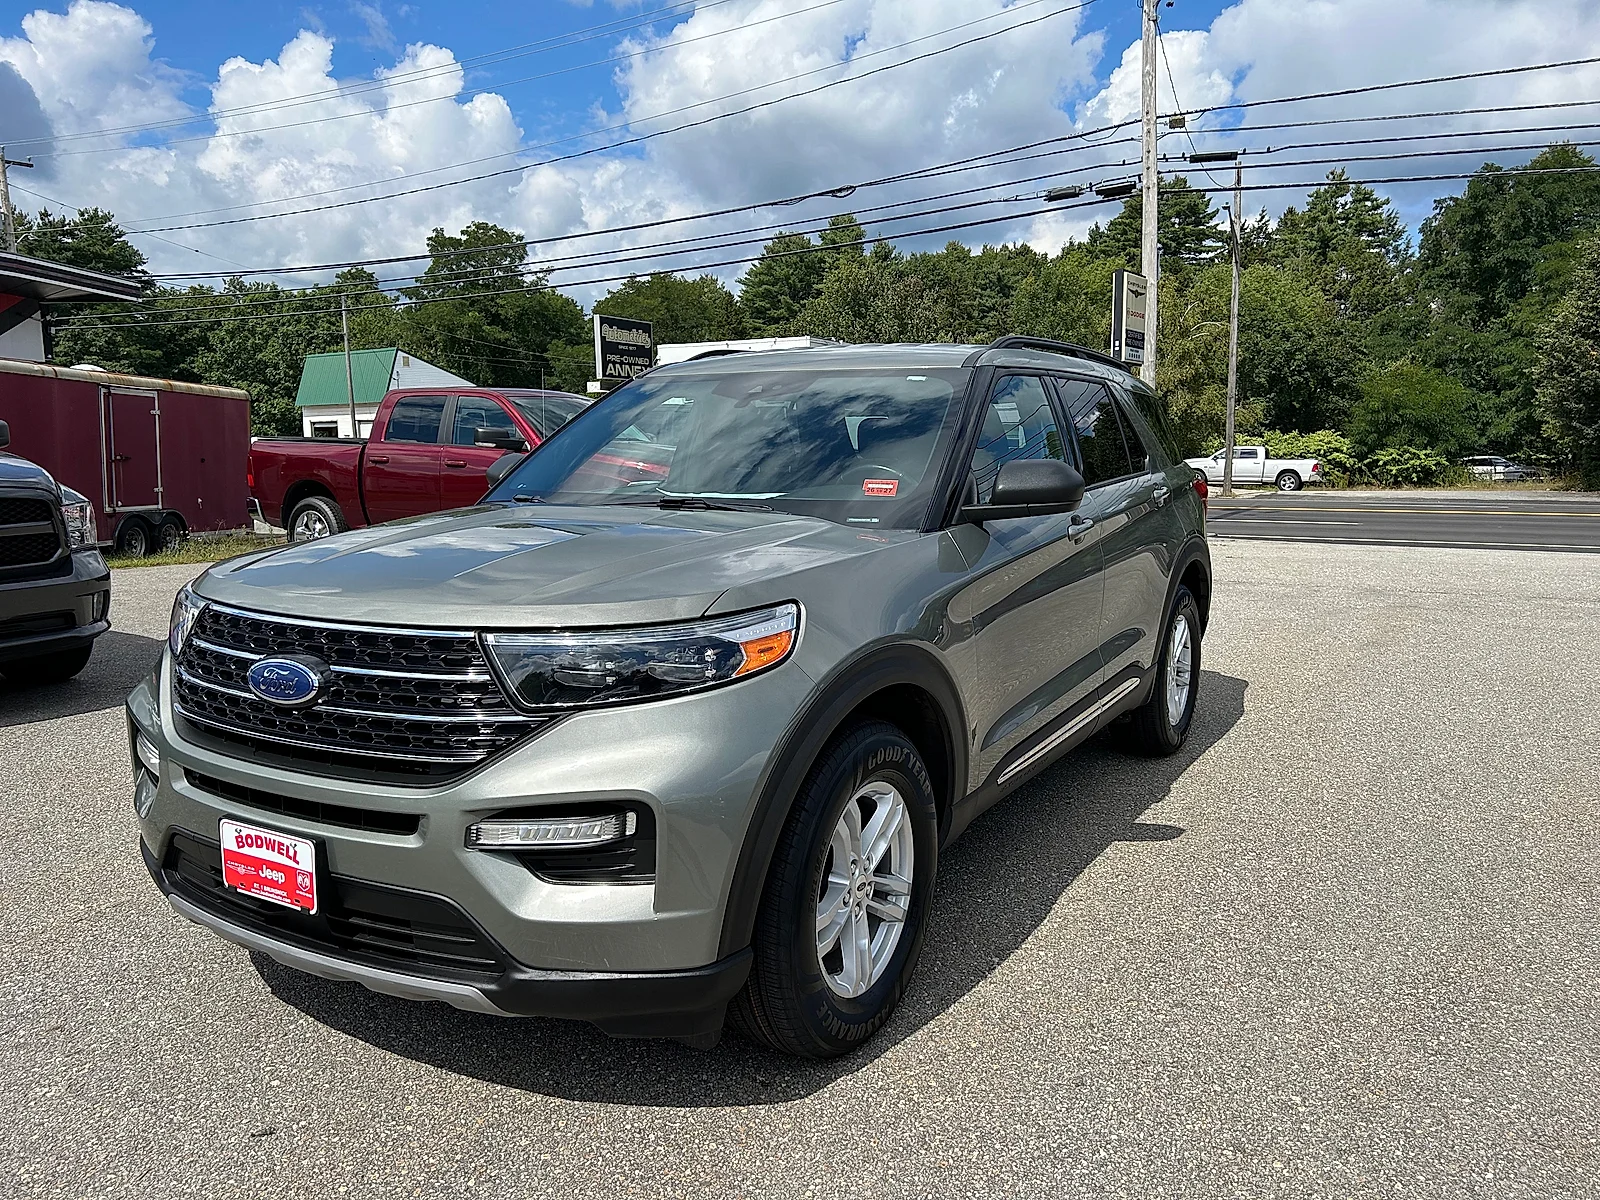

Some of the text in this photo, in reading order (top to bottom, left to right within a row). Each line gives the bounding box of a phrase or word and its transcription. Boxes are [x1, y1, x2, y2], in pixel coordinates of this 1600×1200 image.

[1130, 310, 1145, 319] DODGE
[606, 354, 650, 365] PRE-OWNED
[258, 667, 299, 695] Ford
[867, 745, 932, 798] GOODYEAR
[235, 833, 300, 865] BODWELL
[258, 864, 286, 884] Jeep
[816, 1000, 891, 1042] ASSURANCE
